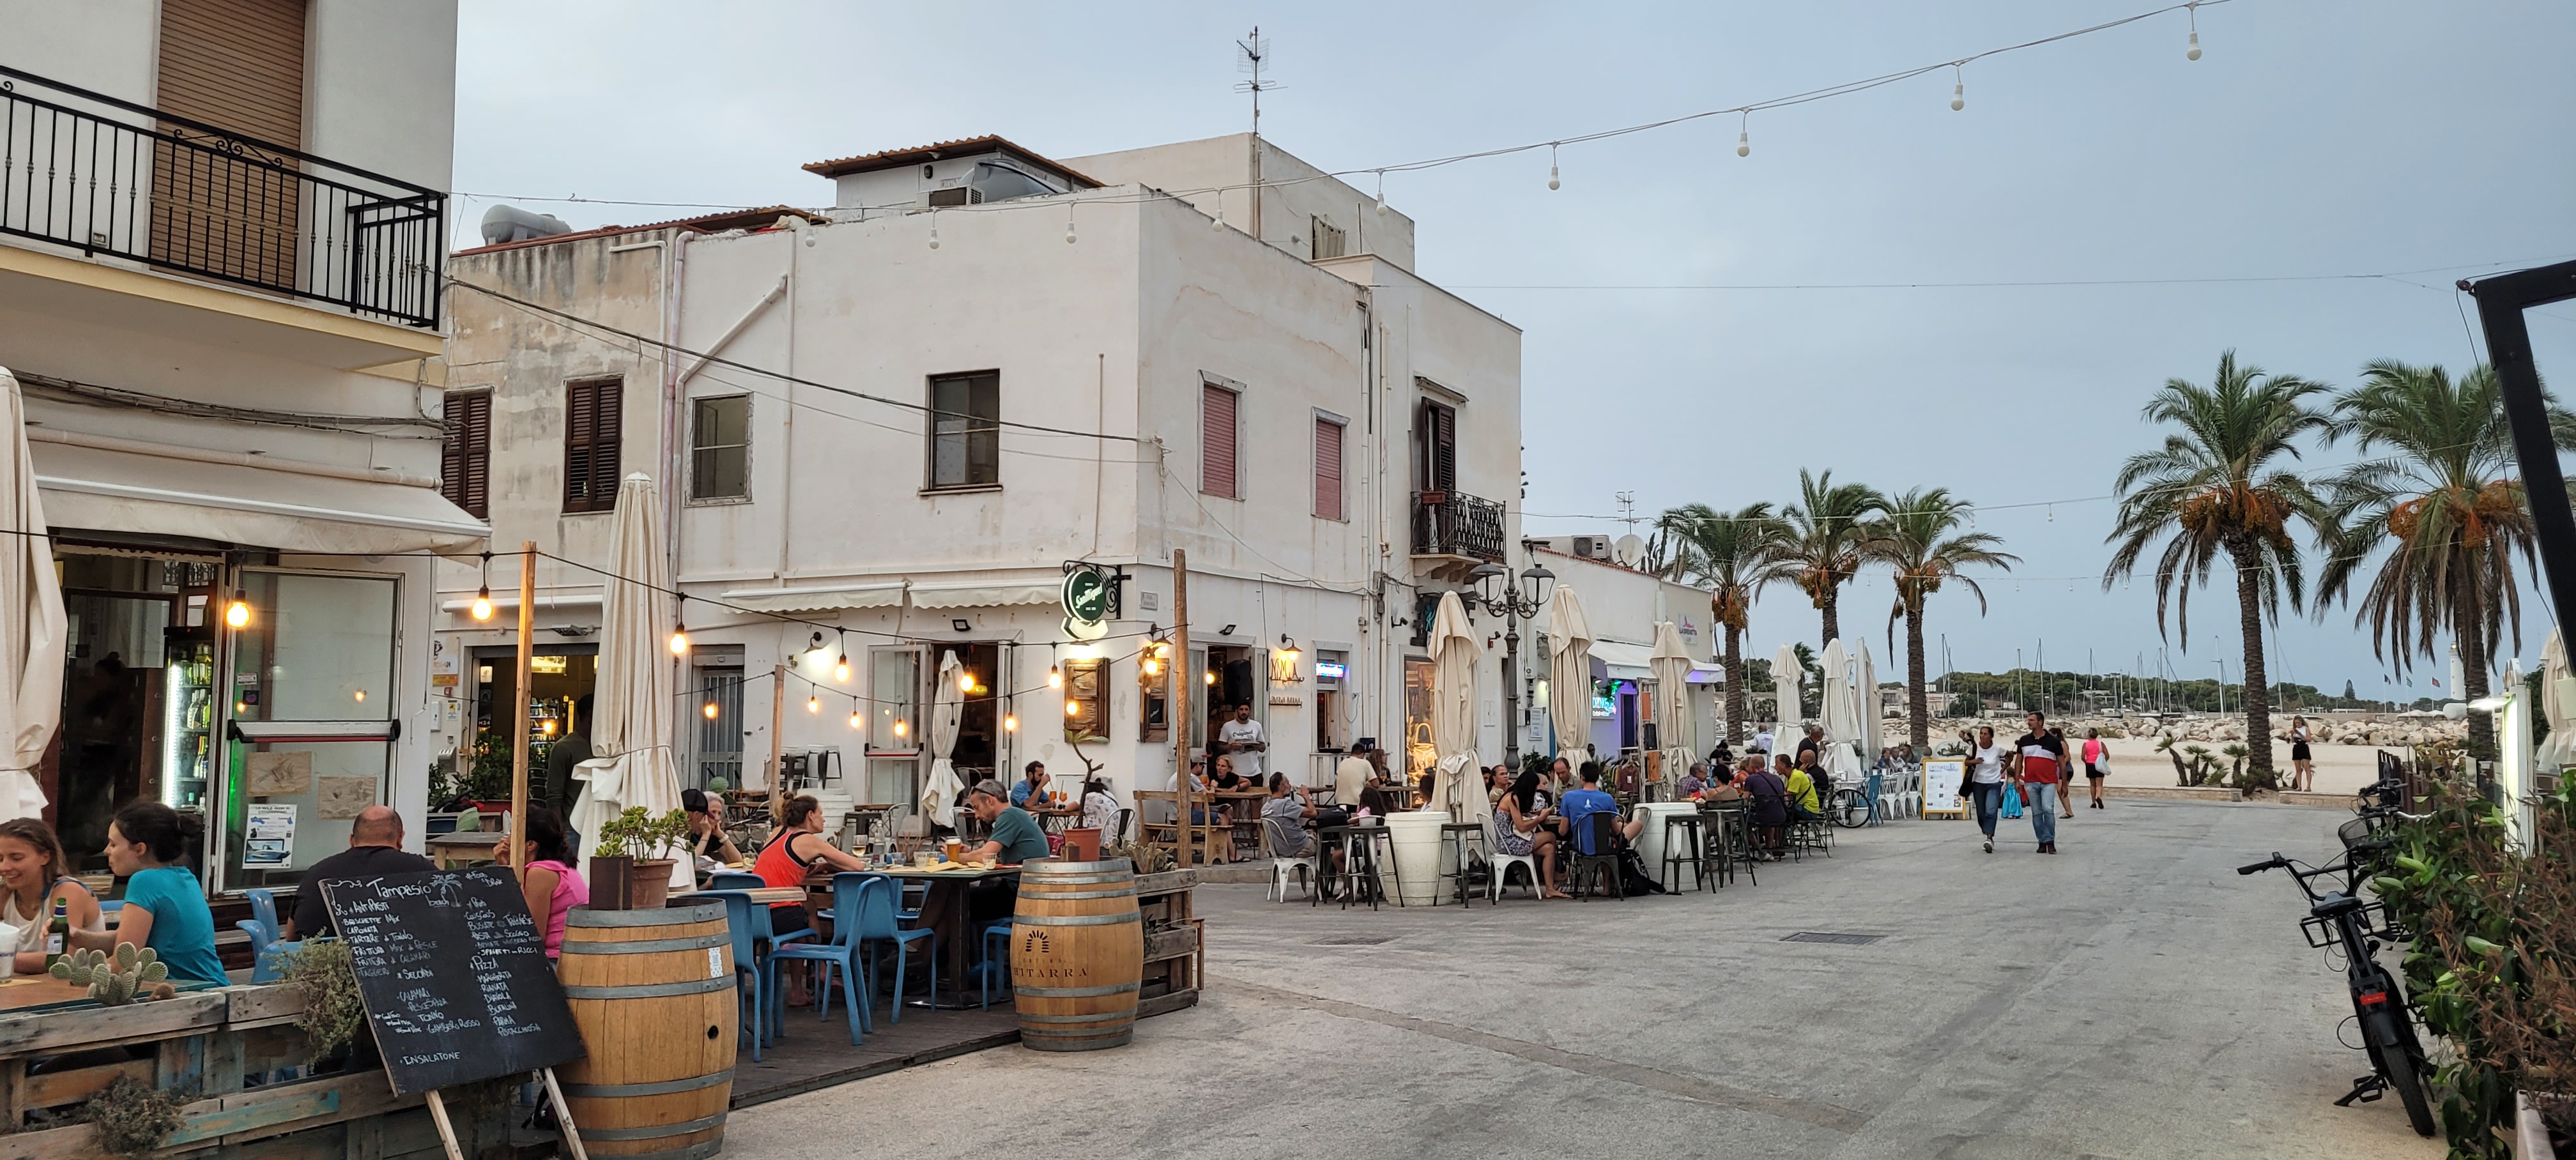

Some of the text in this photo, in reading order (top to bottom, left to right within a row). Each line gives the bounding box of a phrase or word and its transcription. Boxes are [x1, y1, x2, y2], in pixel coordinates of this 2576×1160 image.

[425, 895, 450, 906] beach
[347, 926, 378, 935] CAPONATA
[349, 933, 379, 944] TARTARE
[400, 951, 431, 963] CALAMARI
[471, 955, 498, 970] PIZZA
[1014, 967, 1087, 978] HITARRA
[399, 987, 431, 1002] CALAMARI
[417, 1010, 444, 1022] TONNO
[402, 1052, 460, 1065] INSALATONE
